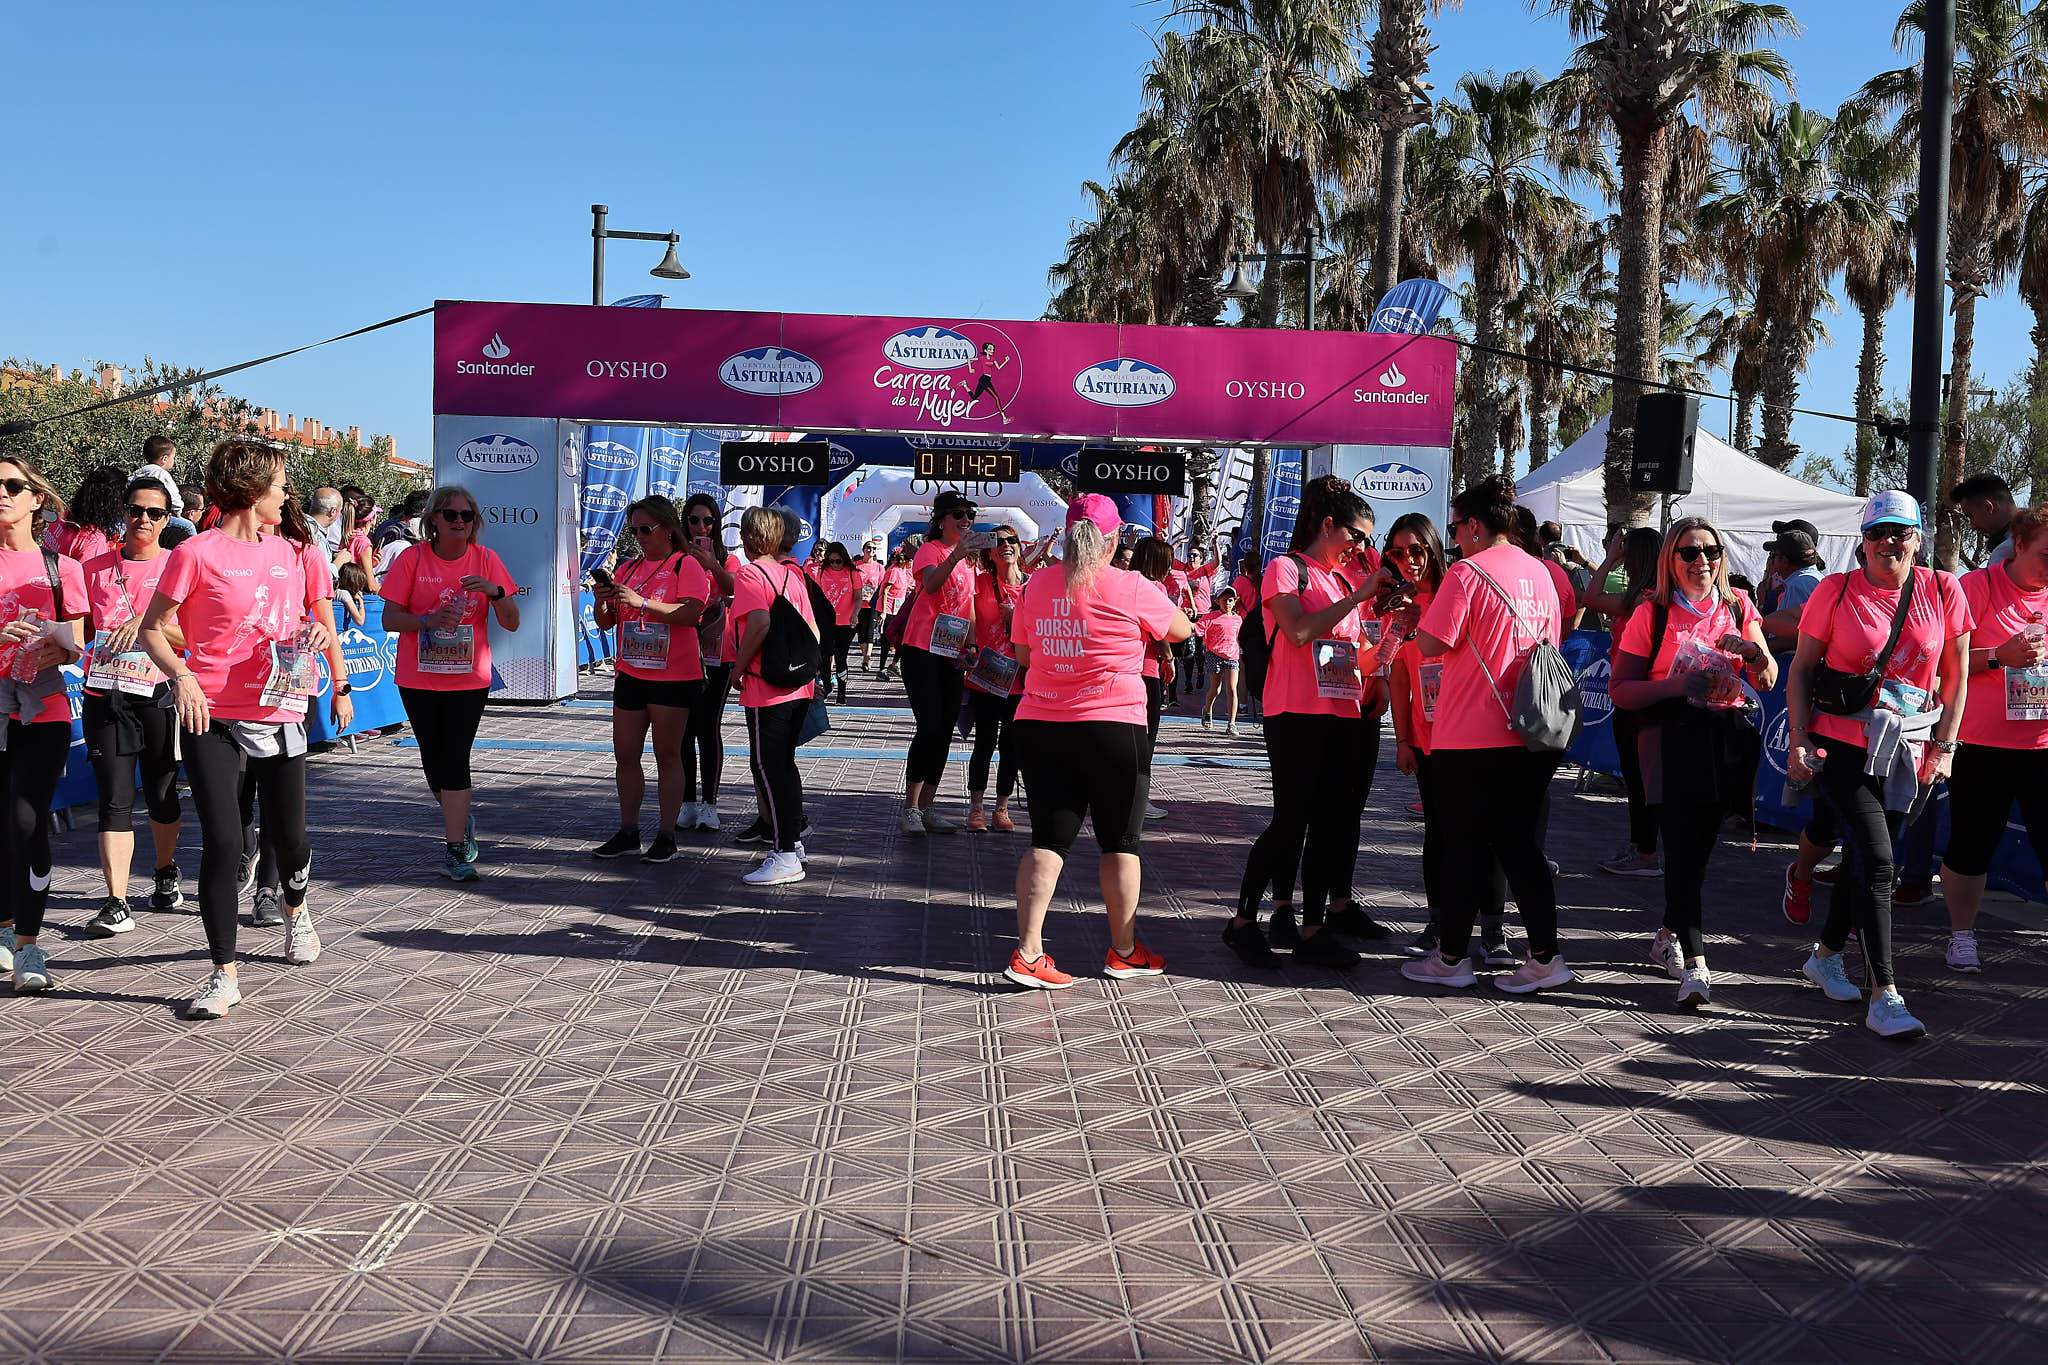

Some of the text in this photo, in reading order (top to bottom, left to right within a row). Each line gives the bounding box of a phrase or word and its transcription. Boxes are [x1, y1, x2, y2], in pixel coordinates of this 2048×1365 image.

[890, 340, 970, 361] ASTURIANA
[456, 360, 536, 376] Santander
[586, 360, 669, 380] OYSHO
[727, 363, 815, 384] ASTURIANA
[873, 365, 951, 390] Carrera
[1082, 374, 1168, 396] ASTURIANA
[1225, 380, 1305, 400] OYSHO
[1353, 388, 1430, 405] Santander
[891, 389, 979, 427] de la Mujer
[463, 447, 533, 464] ASTURIANA
[738, 455, 815, 473] OYSHO
[921, 453, 1012, 477] 01:14:27
[1094, 463, 1171, 482] OYSHO
[1276, 471, 1302, 481] ASTURI
[1360, 476, 1427, 492] ASTURIANA
[853, 496, 882, 504] OYSHO
[1029, 499, 1058, 507] OYSHO
[479, 506, 540, 525] YSHO
[1518, 578, 1534, 598] TU
[1052, 598, 1071, 617] TU
[1035, 619, 1090, 638] DORSAL
[1042, 639, 1085, 657] SUMA
